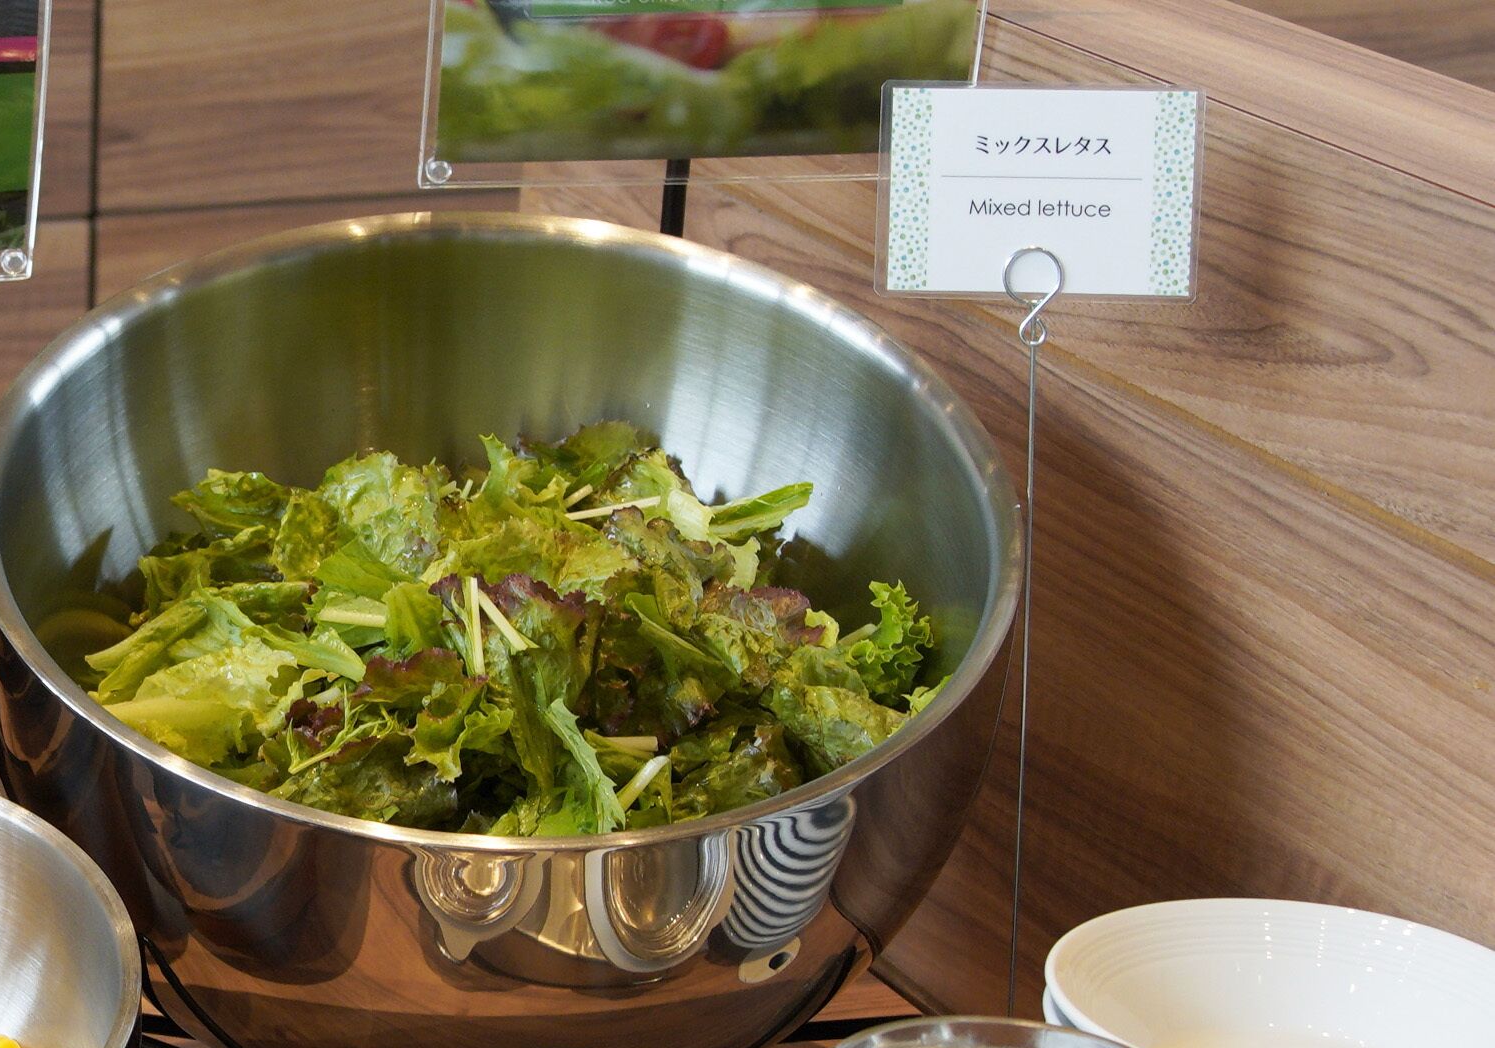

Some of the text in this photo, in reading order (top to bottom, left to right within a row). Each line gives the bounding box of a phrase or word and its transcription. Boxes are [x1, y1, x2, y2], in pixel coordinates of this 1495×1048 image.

[975, 134, 1112, 156] ミックスレタス
[969, 198, 1112, 218] Mixed lettuce
